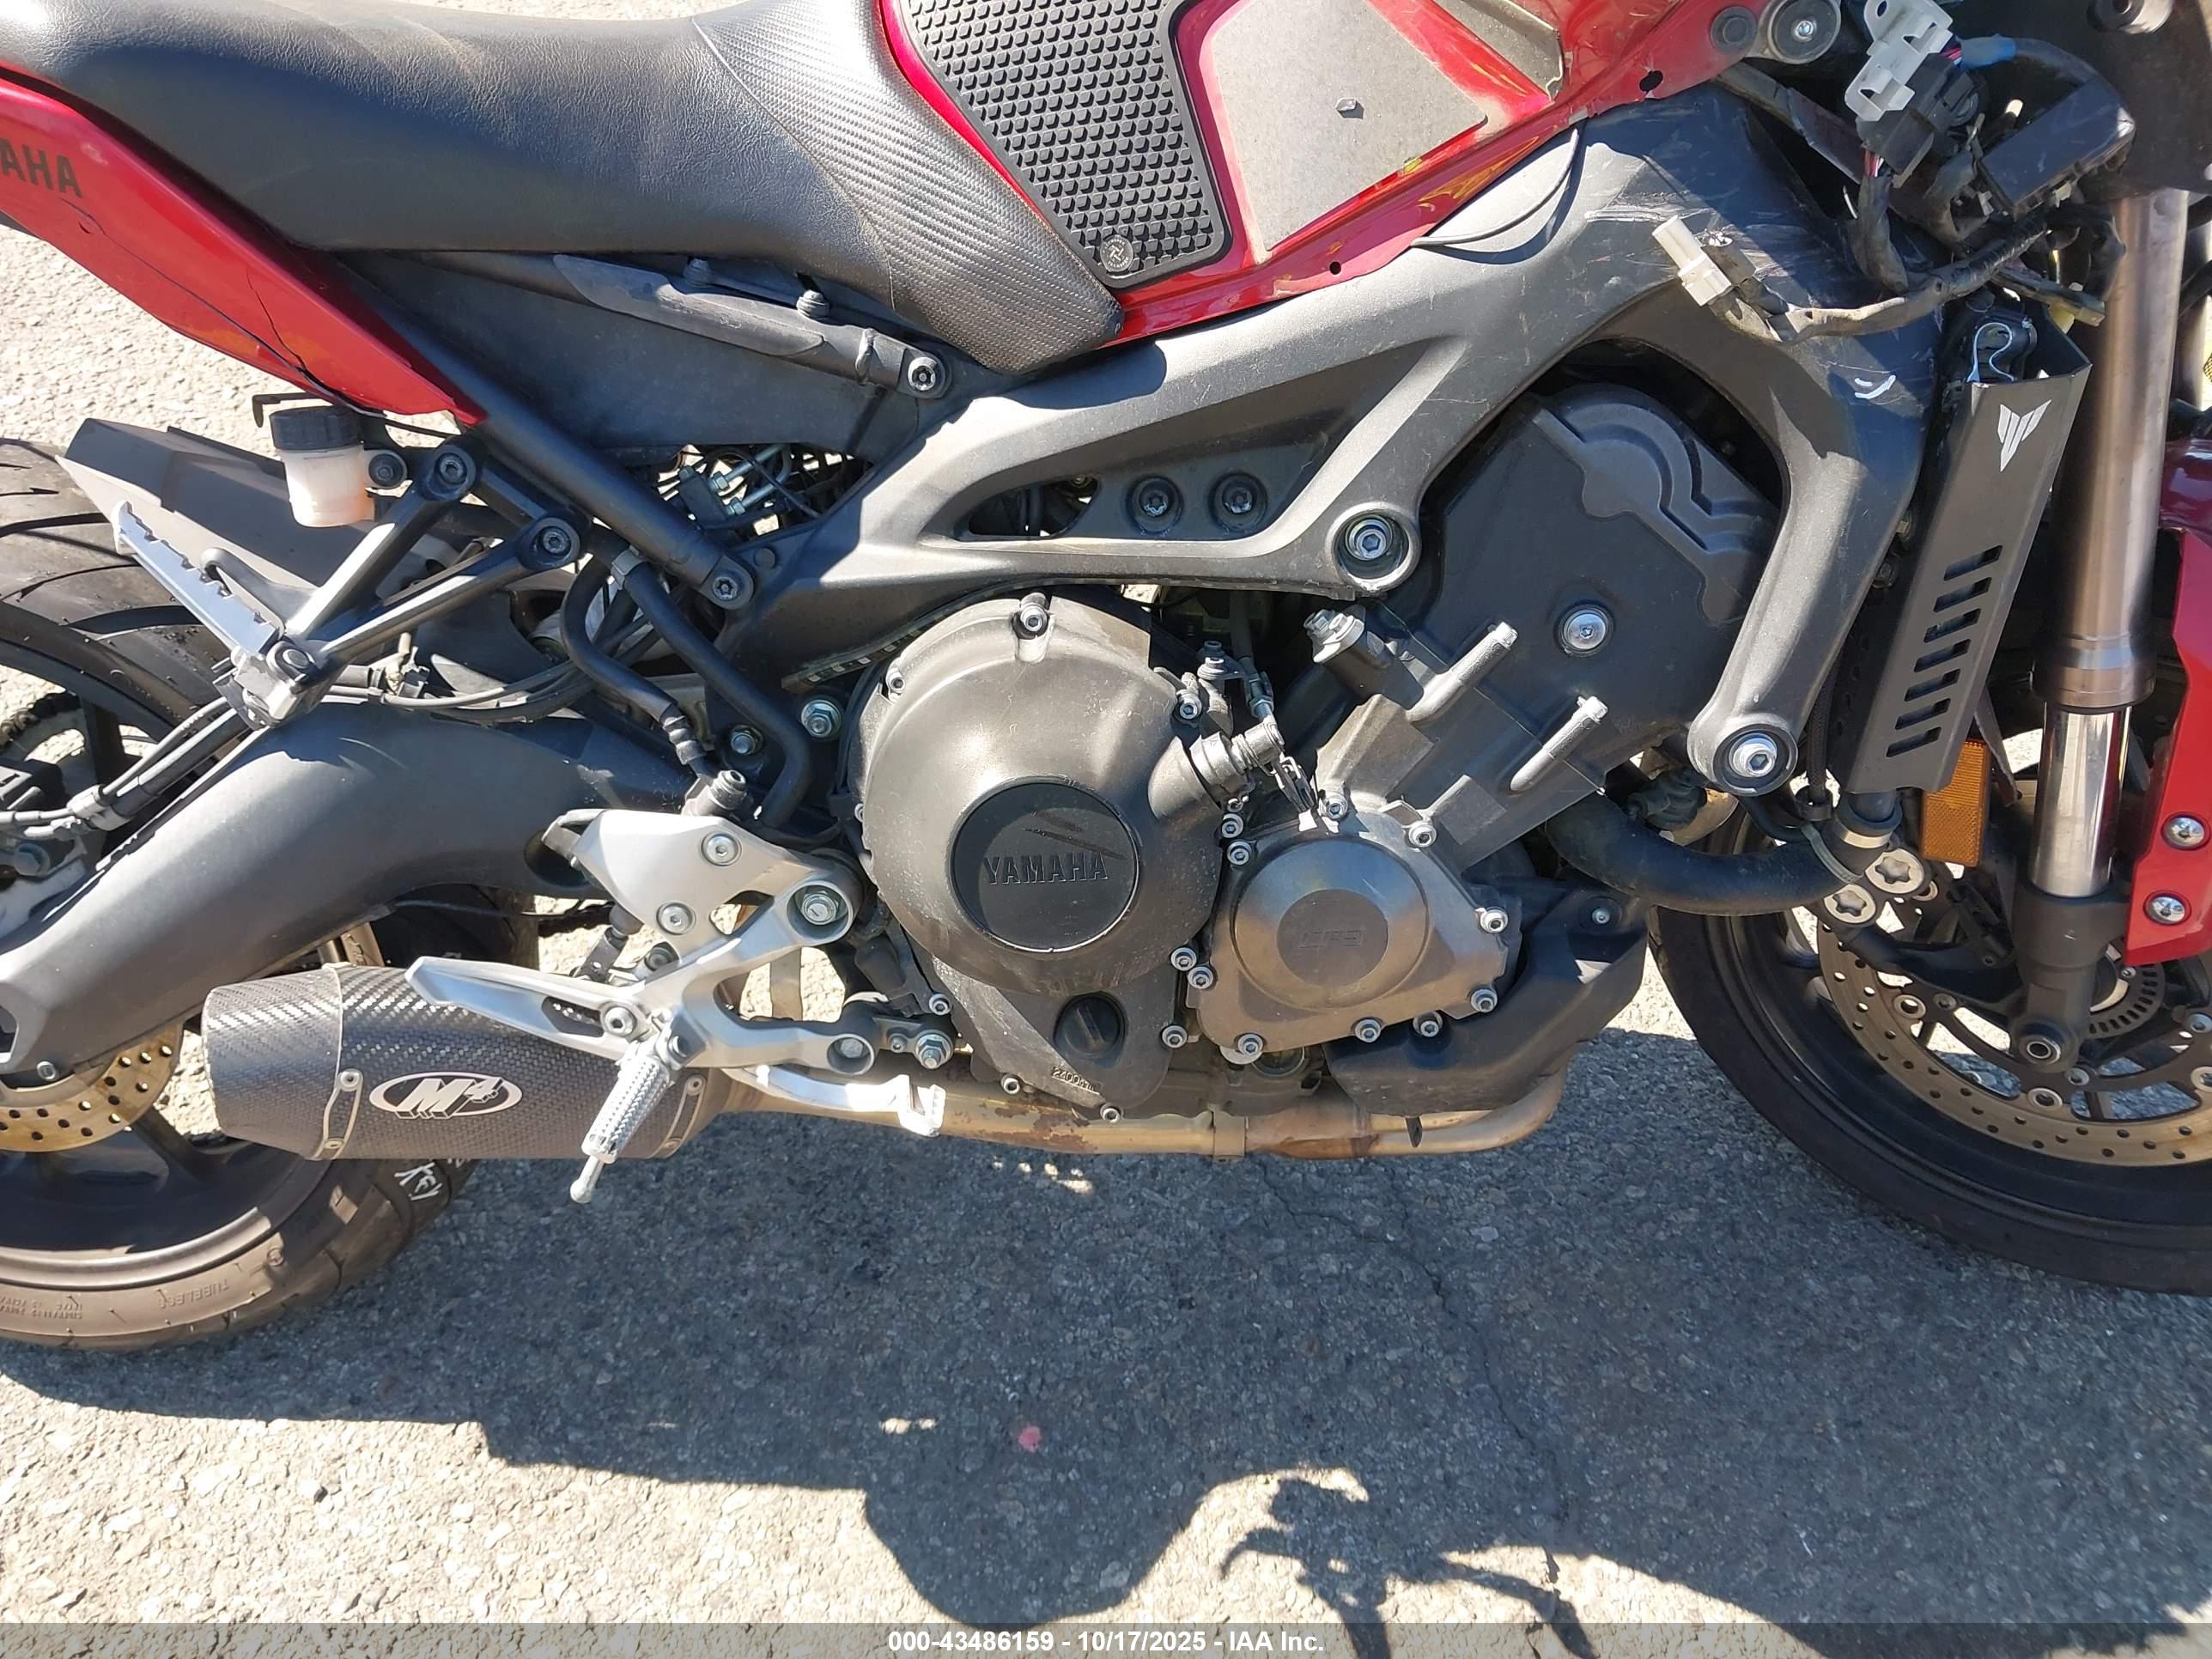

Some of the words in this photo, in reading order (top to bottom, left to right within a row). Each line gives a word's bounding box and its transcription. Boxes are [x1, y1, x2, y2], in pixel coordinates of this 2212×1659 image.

[984, 851, 1109, 885] YAMAHA
[395, 1077, 504, 1120] M4
[158, 1278, 231, 1310] TUBELESS
